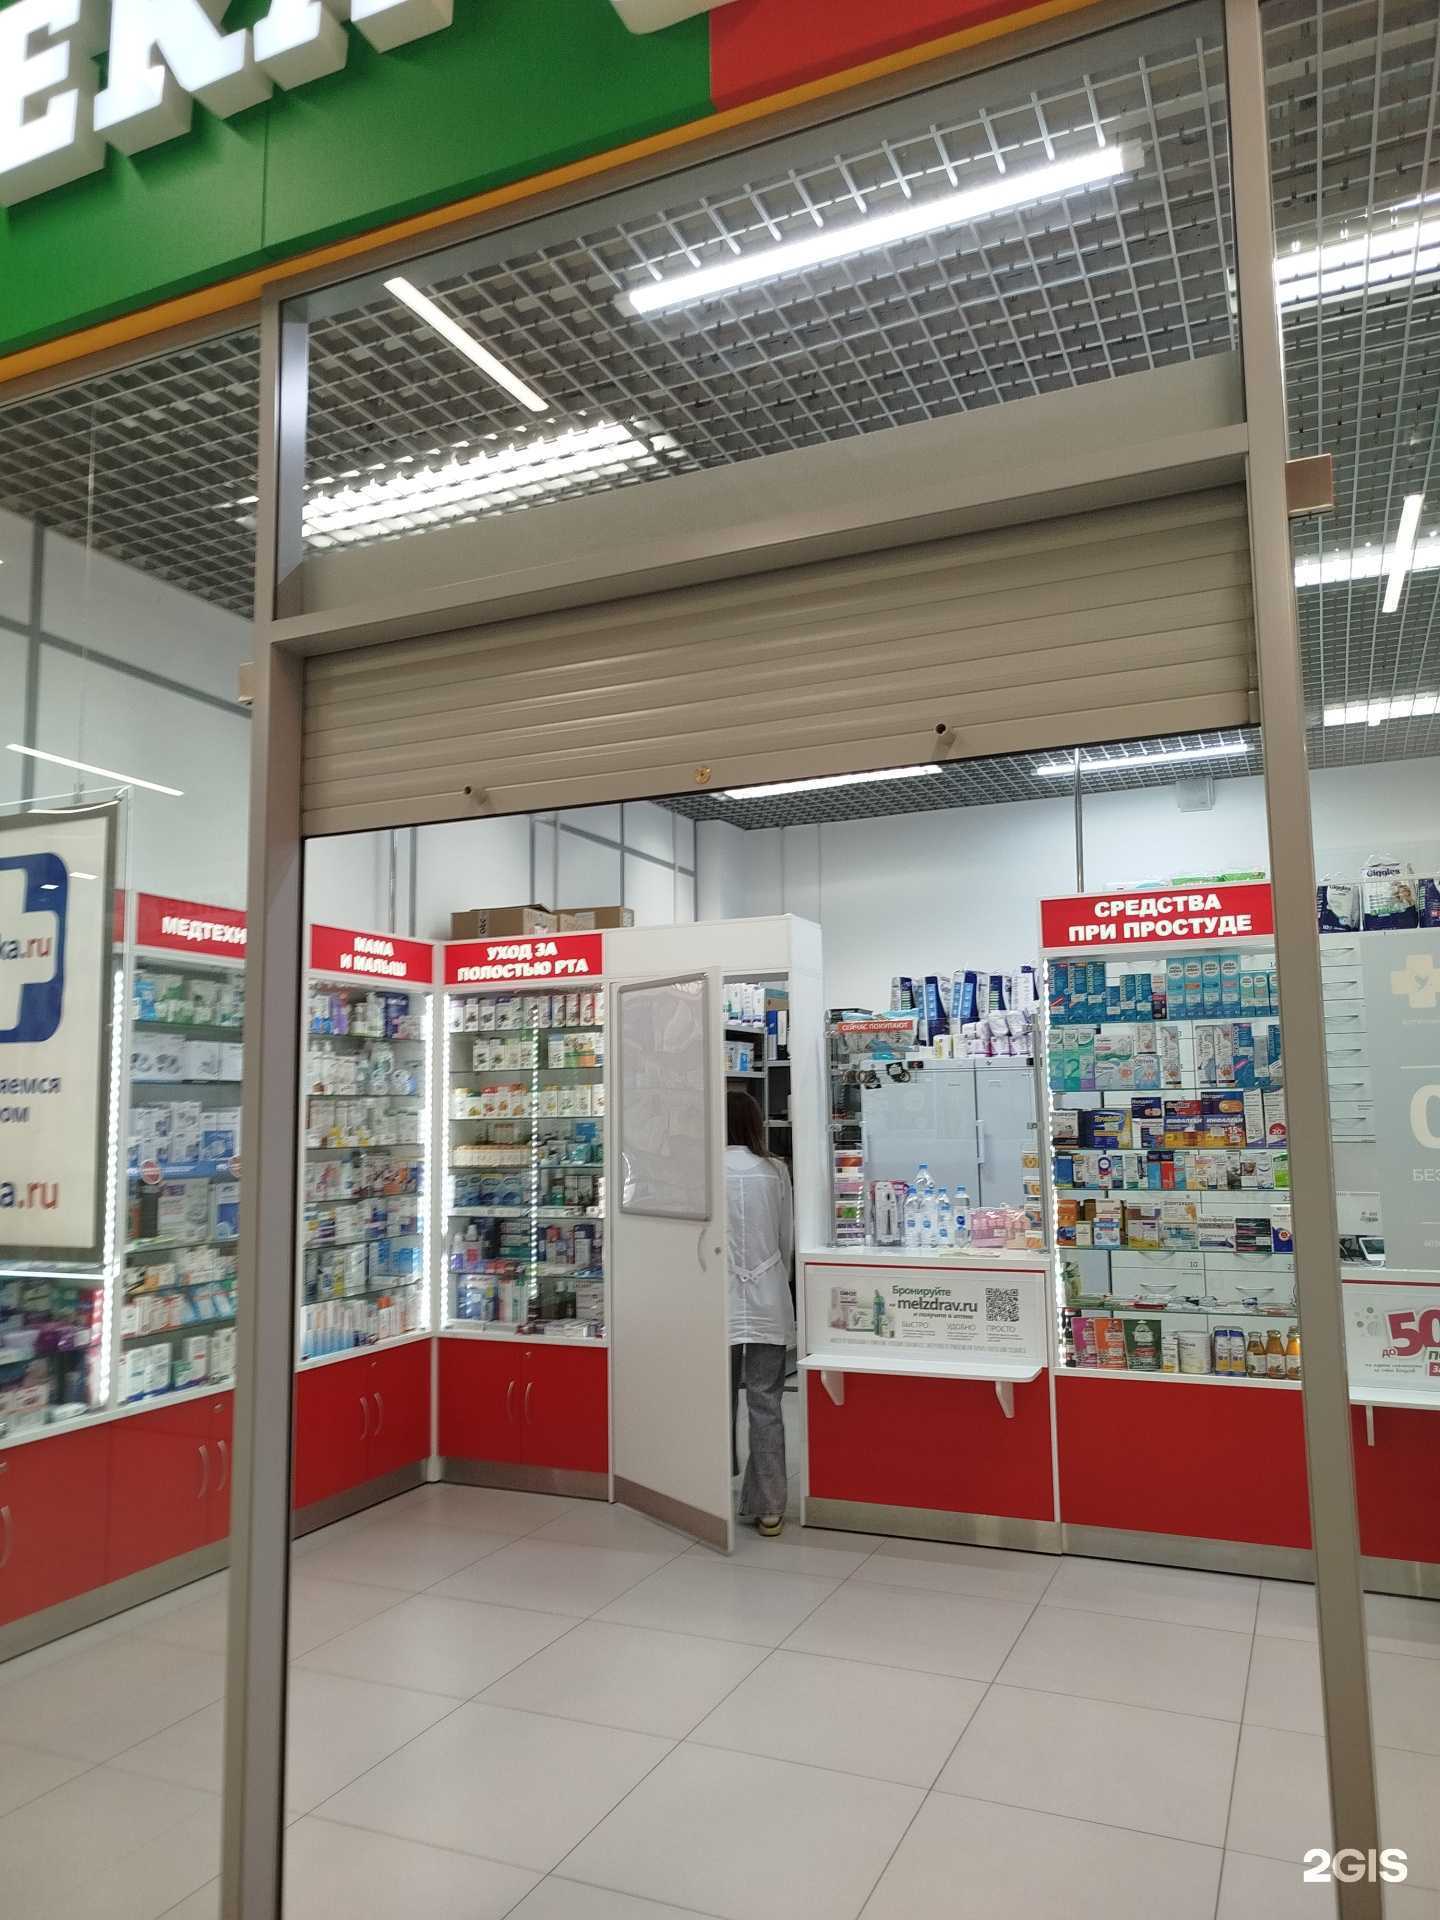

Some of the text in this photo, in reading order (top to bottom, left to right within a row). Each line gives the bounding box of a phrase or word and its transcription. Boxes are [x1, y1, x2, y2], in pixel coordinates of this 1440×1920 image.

[1094, 893, 1223, 917] СРЕДСТВА
[1068, 914, 1253, 942] ПРИ ПРОСТУДЕ
[353, 936, 395, 957] МАМА
[486, 941, 559, 961] УХОД ЗА
[340, 953, 408, 977] И МАЛЫШ
[457, 957, 590, 982] ПОЛОСТЬЮ РТА
[892, 1285, 952, 1304] Бронируйте
